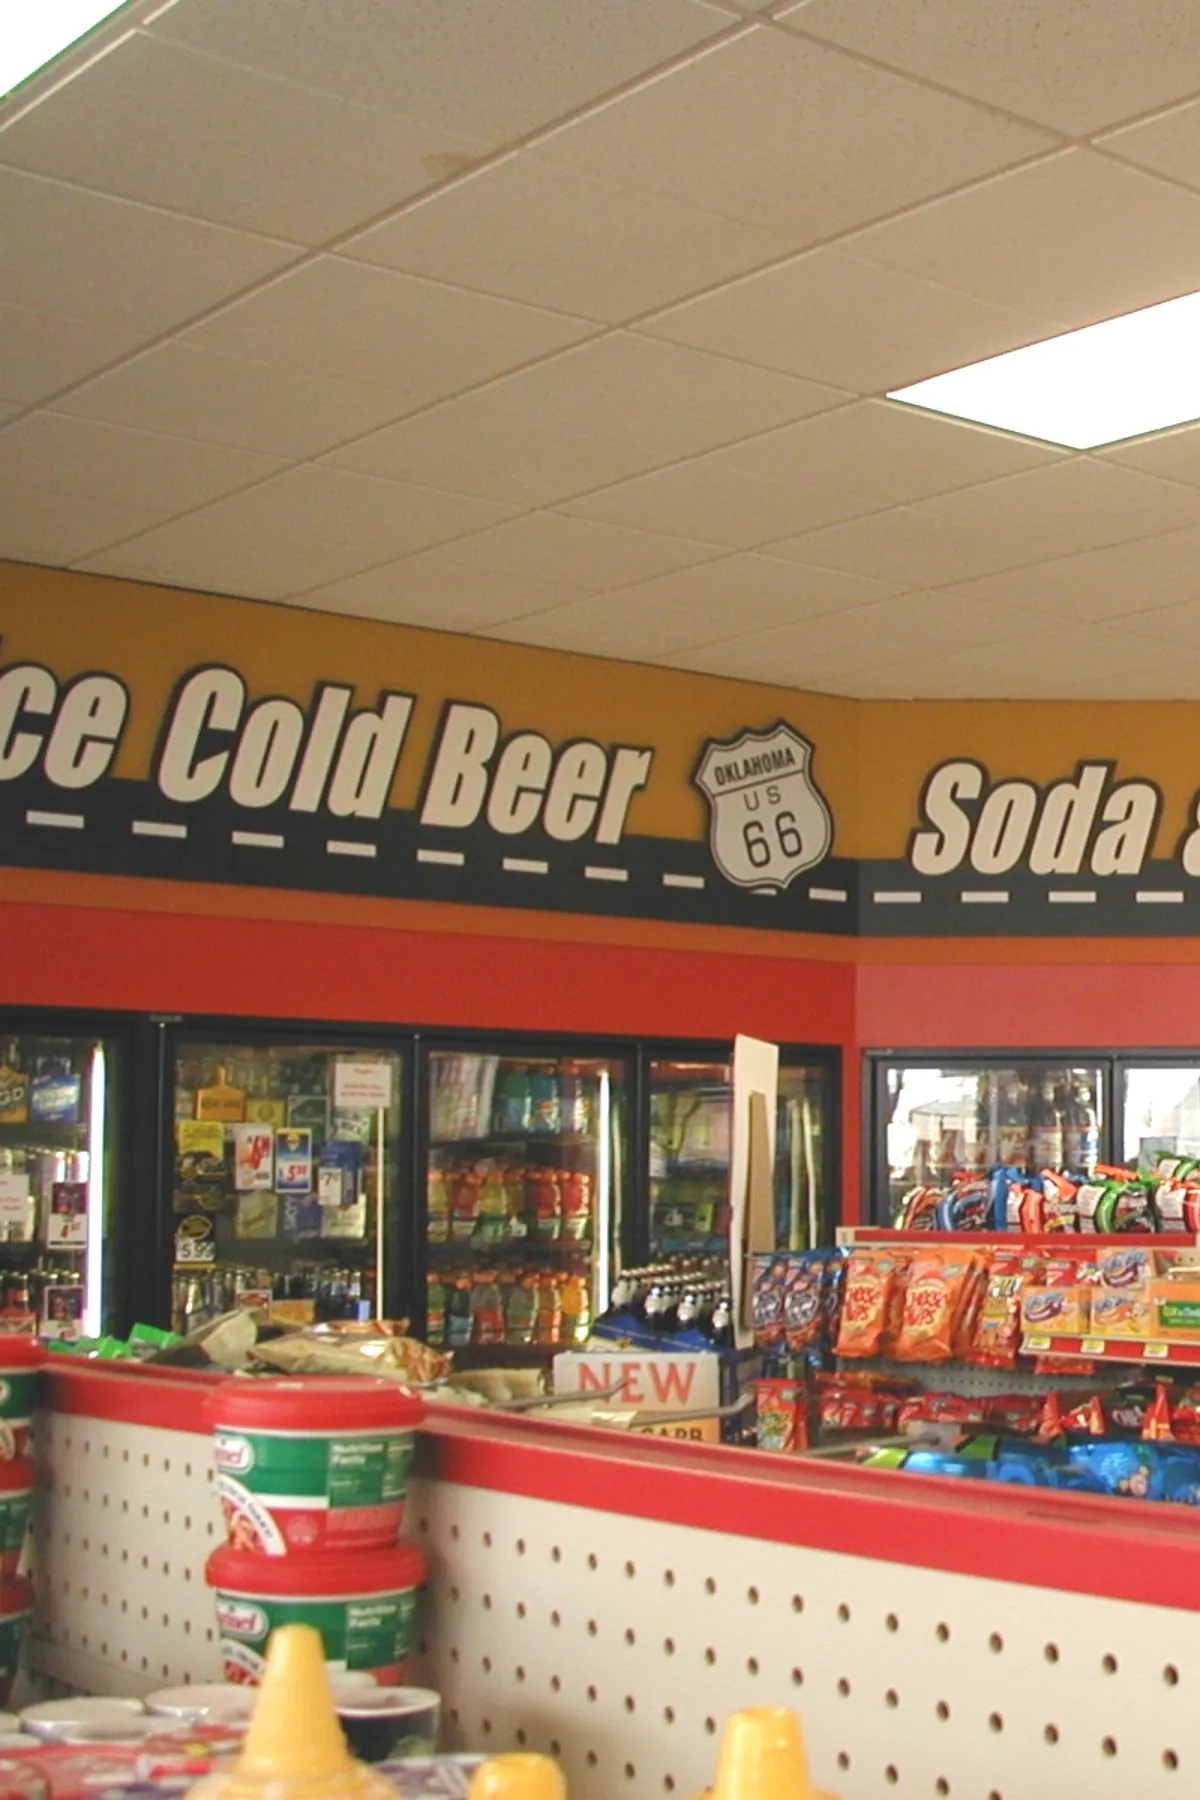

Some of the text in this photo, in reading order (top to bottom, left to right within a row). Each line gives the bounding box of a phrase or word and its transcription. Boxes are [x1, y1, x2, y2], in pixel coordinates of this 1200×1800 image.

[0, 665, 653, 844] ce Cold Beer
[714, 747, 796, 786] OKLAHOMA
[742, 811, 802, 868] 66
[911, 760, 1160, 876] Soda
[577, 1361, 697, 1406] NEW
